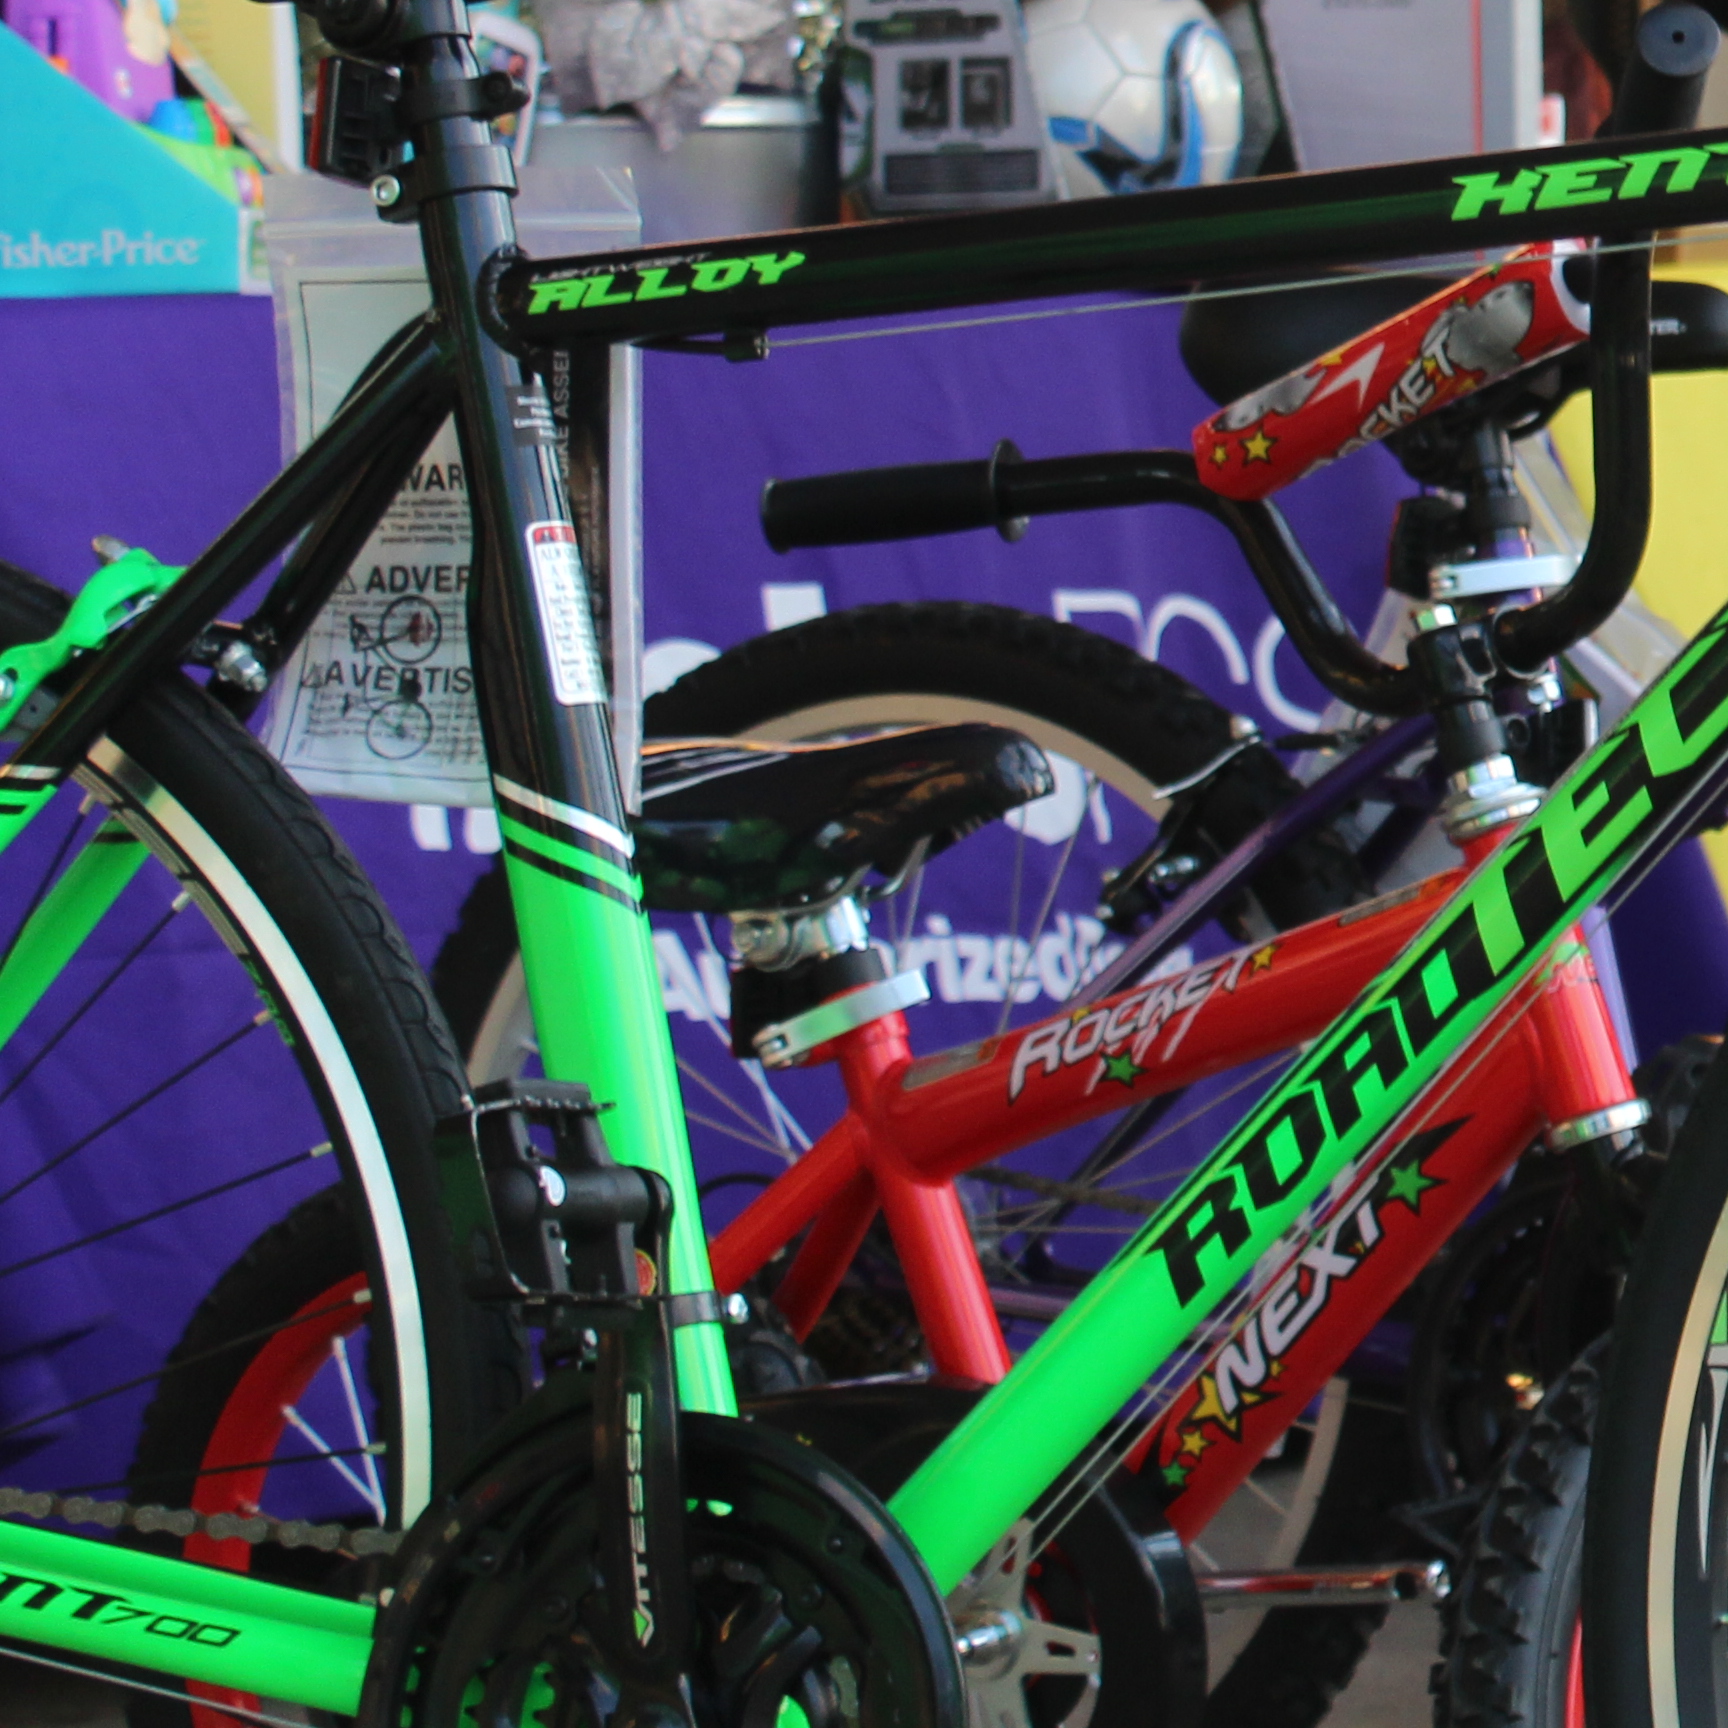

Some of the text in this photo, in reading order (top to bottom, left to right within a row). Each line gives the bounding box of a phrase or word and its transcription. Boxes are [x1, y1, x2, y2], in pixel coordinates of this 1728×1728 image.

[0, 229, 200, 269] isher-Price
[527, 251, 806, 315] ALLOY
[1007, 942, 1258, 1105] ROCKET
[1215, 1172, 1384, 1415] NEXT
[102, 1599, 242, 1648] 700
